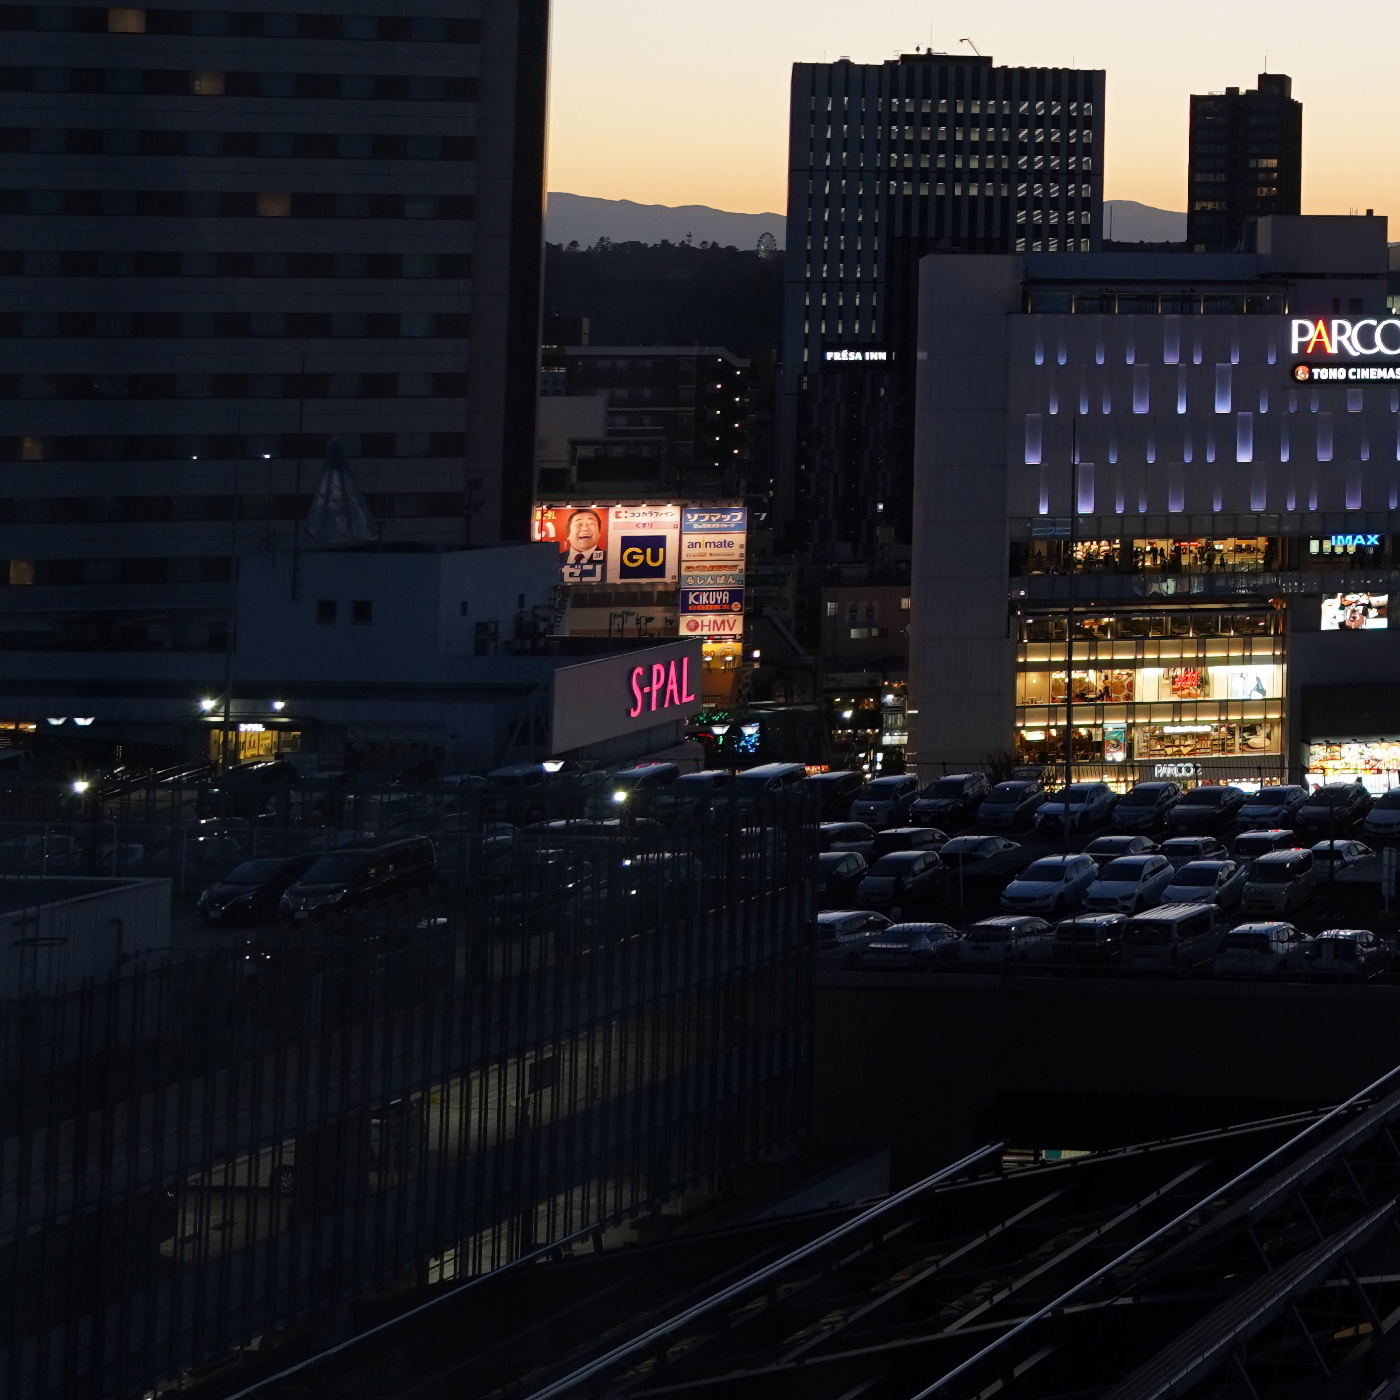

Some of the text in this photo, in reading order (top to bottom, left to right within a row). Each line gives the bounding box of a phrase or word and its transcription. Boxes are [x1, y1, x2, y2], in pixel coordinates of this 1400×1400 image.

[865, 351, 887, 360] INN
[1312, 368, 1347, 379] TOHO
[686, 511, 743, 522] ソフマップ
[687, 537, 735, 549] animate
[1331, 534, 1379, 547] IMAX
[593, 551, 603, 559] 3F
[622, 547, 664, 567] GU
[561, 564, 603, 583] ゼン
[686, 576, 736, 585] らしんばん
[689, 591, 729, 604] KIKUYA
[701, 619, 737, 632] HMV
[630, 656, 695, 718] S-PAL
[1154, 763, 1194, 778] PARCO
